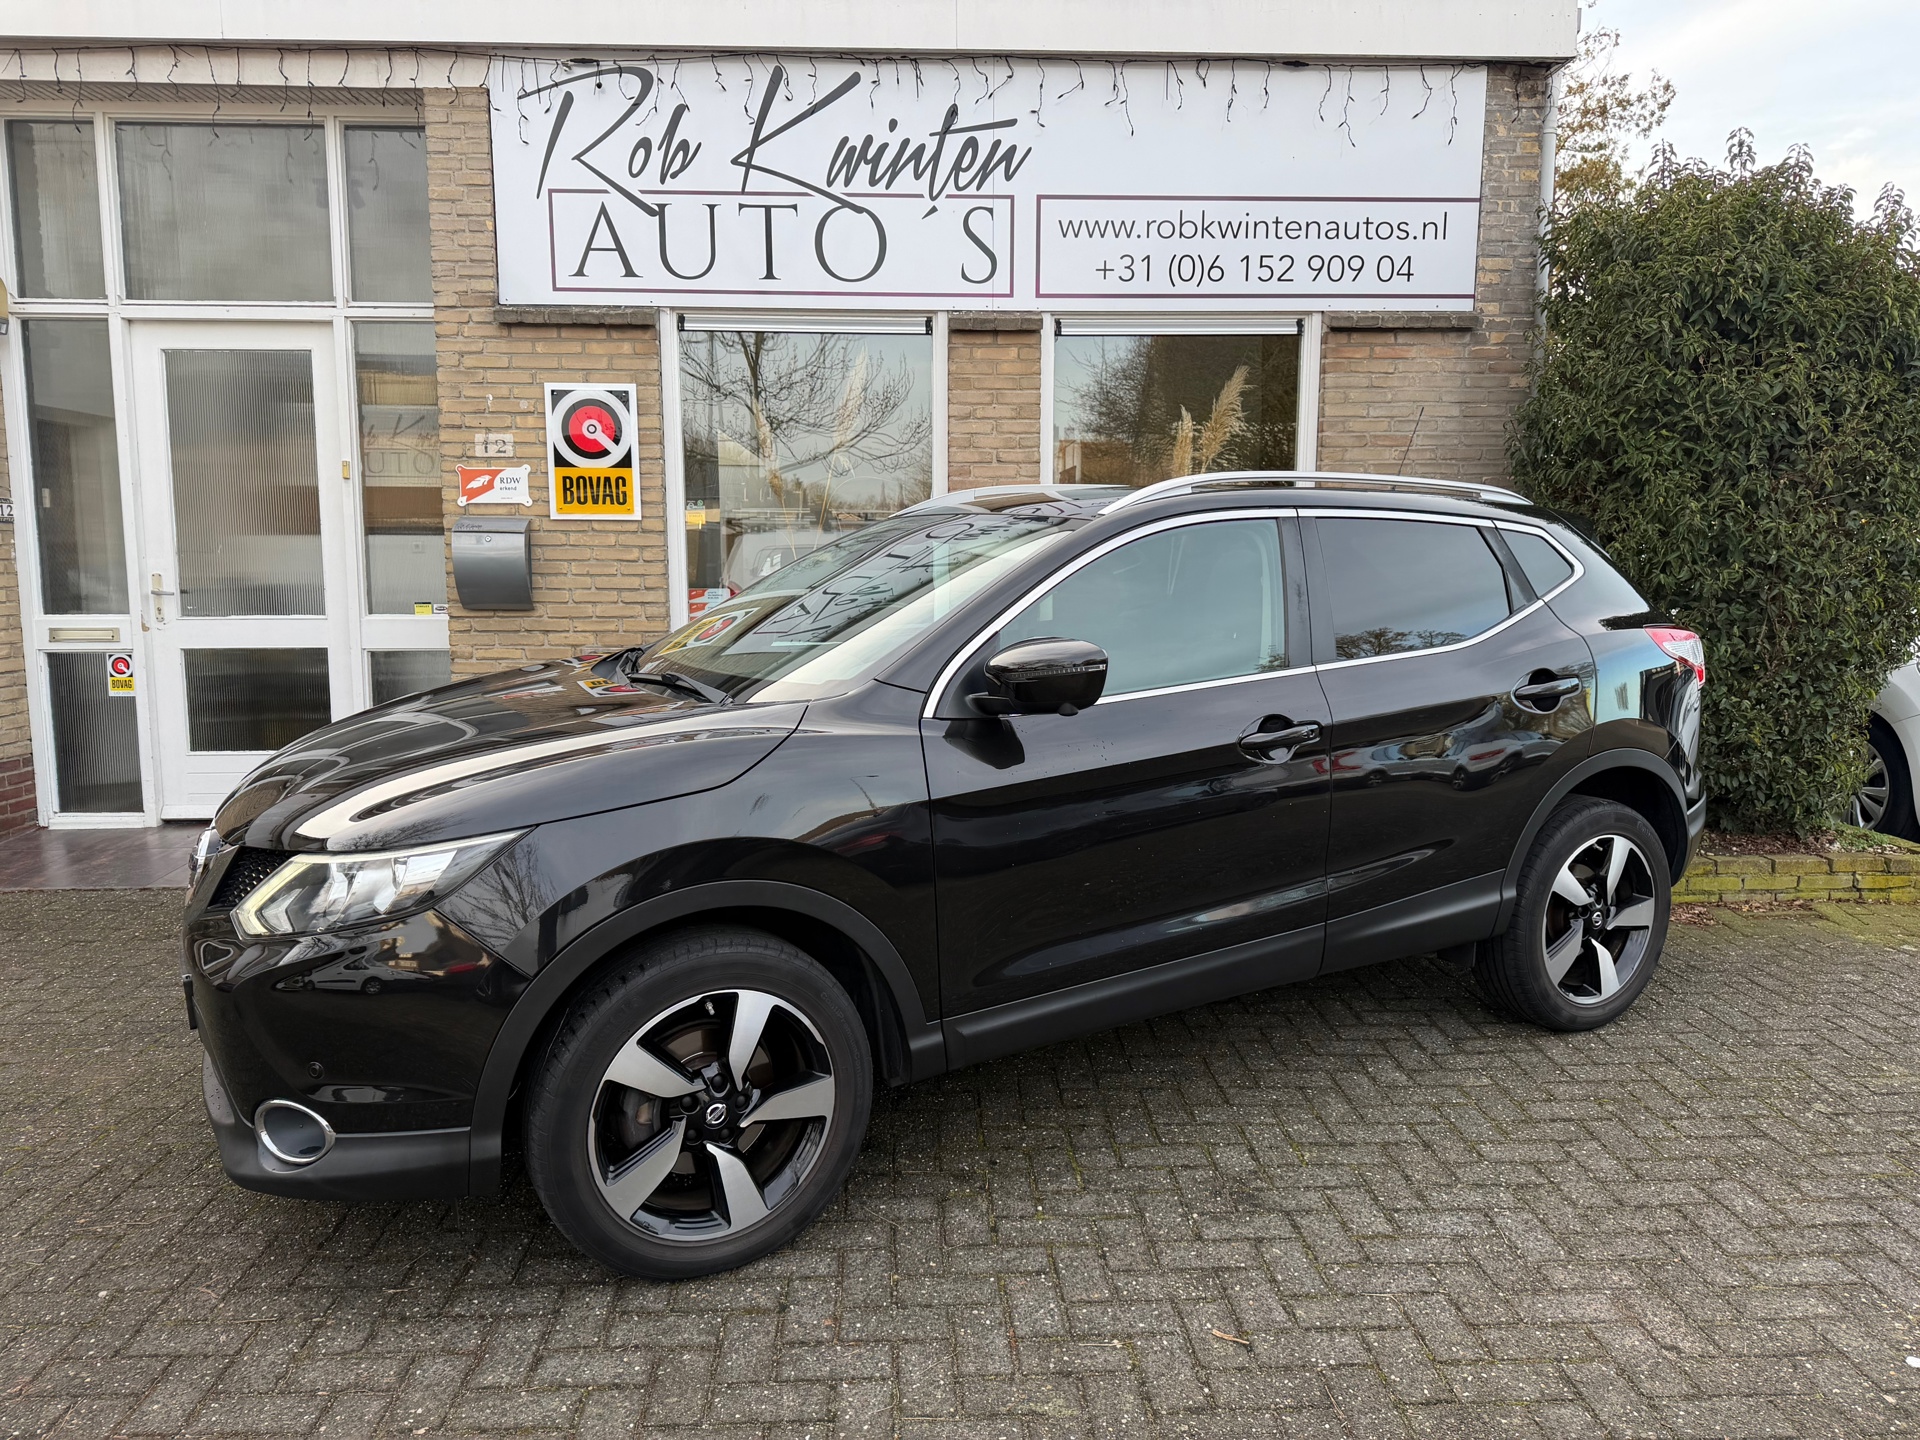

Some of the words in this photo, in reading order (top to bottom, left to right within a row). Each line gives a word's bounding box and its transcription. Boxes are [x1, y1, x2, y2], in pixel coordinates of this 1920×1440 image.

[517, 66, 701, 217] Rob
[730, 65, 1033, 214] Kwinten
[1058, 210, 1448, 240] www.robkwintenautos.nl
[1095, 254, 1152, 282] +31
[1168, 253, 1225, 287] (0)6
[1240, 254, 1295, 282] 152
[1307, 254, 1365, 282] 909
[1376, 255, 1415, 282] 04
[562, 475, 628, 506] BOVAG
[111, 679, 133, 689] BOVAG
